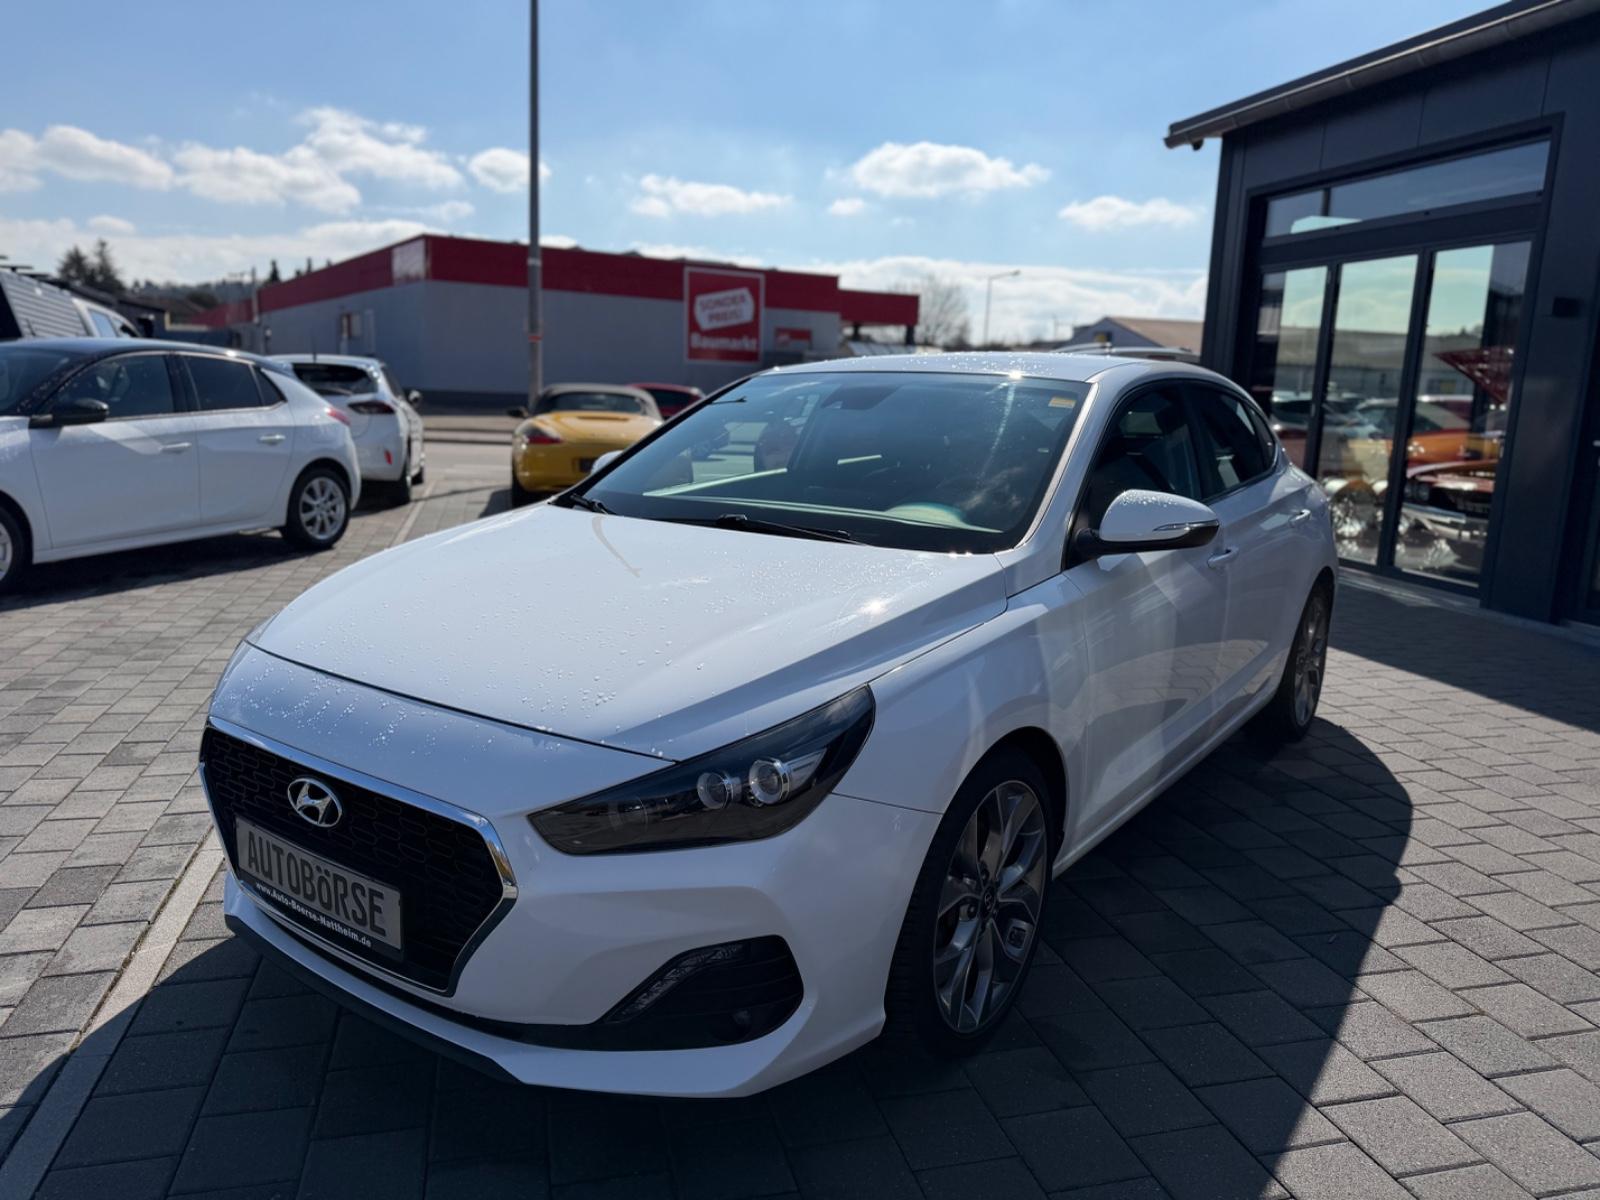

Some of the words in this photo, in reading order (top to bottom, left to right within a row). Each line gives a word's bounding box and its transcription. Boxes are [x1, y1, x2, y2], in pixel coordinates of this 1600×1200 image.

[691, 332, 757, 350] Baumarkt
[248, 830, 386, 935] AUTOBÖRSE
[256, 882, 372, 948] www.Auto-Boerse-Nattheim.de
